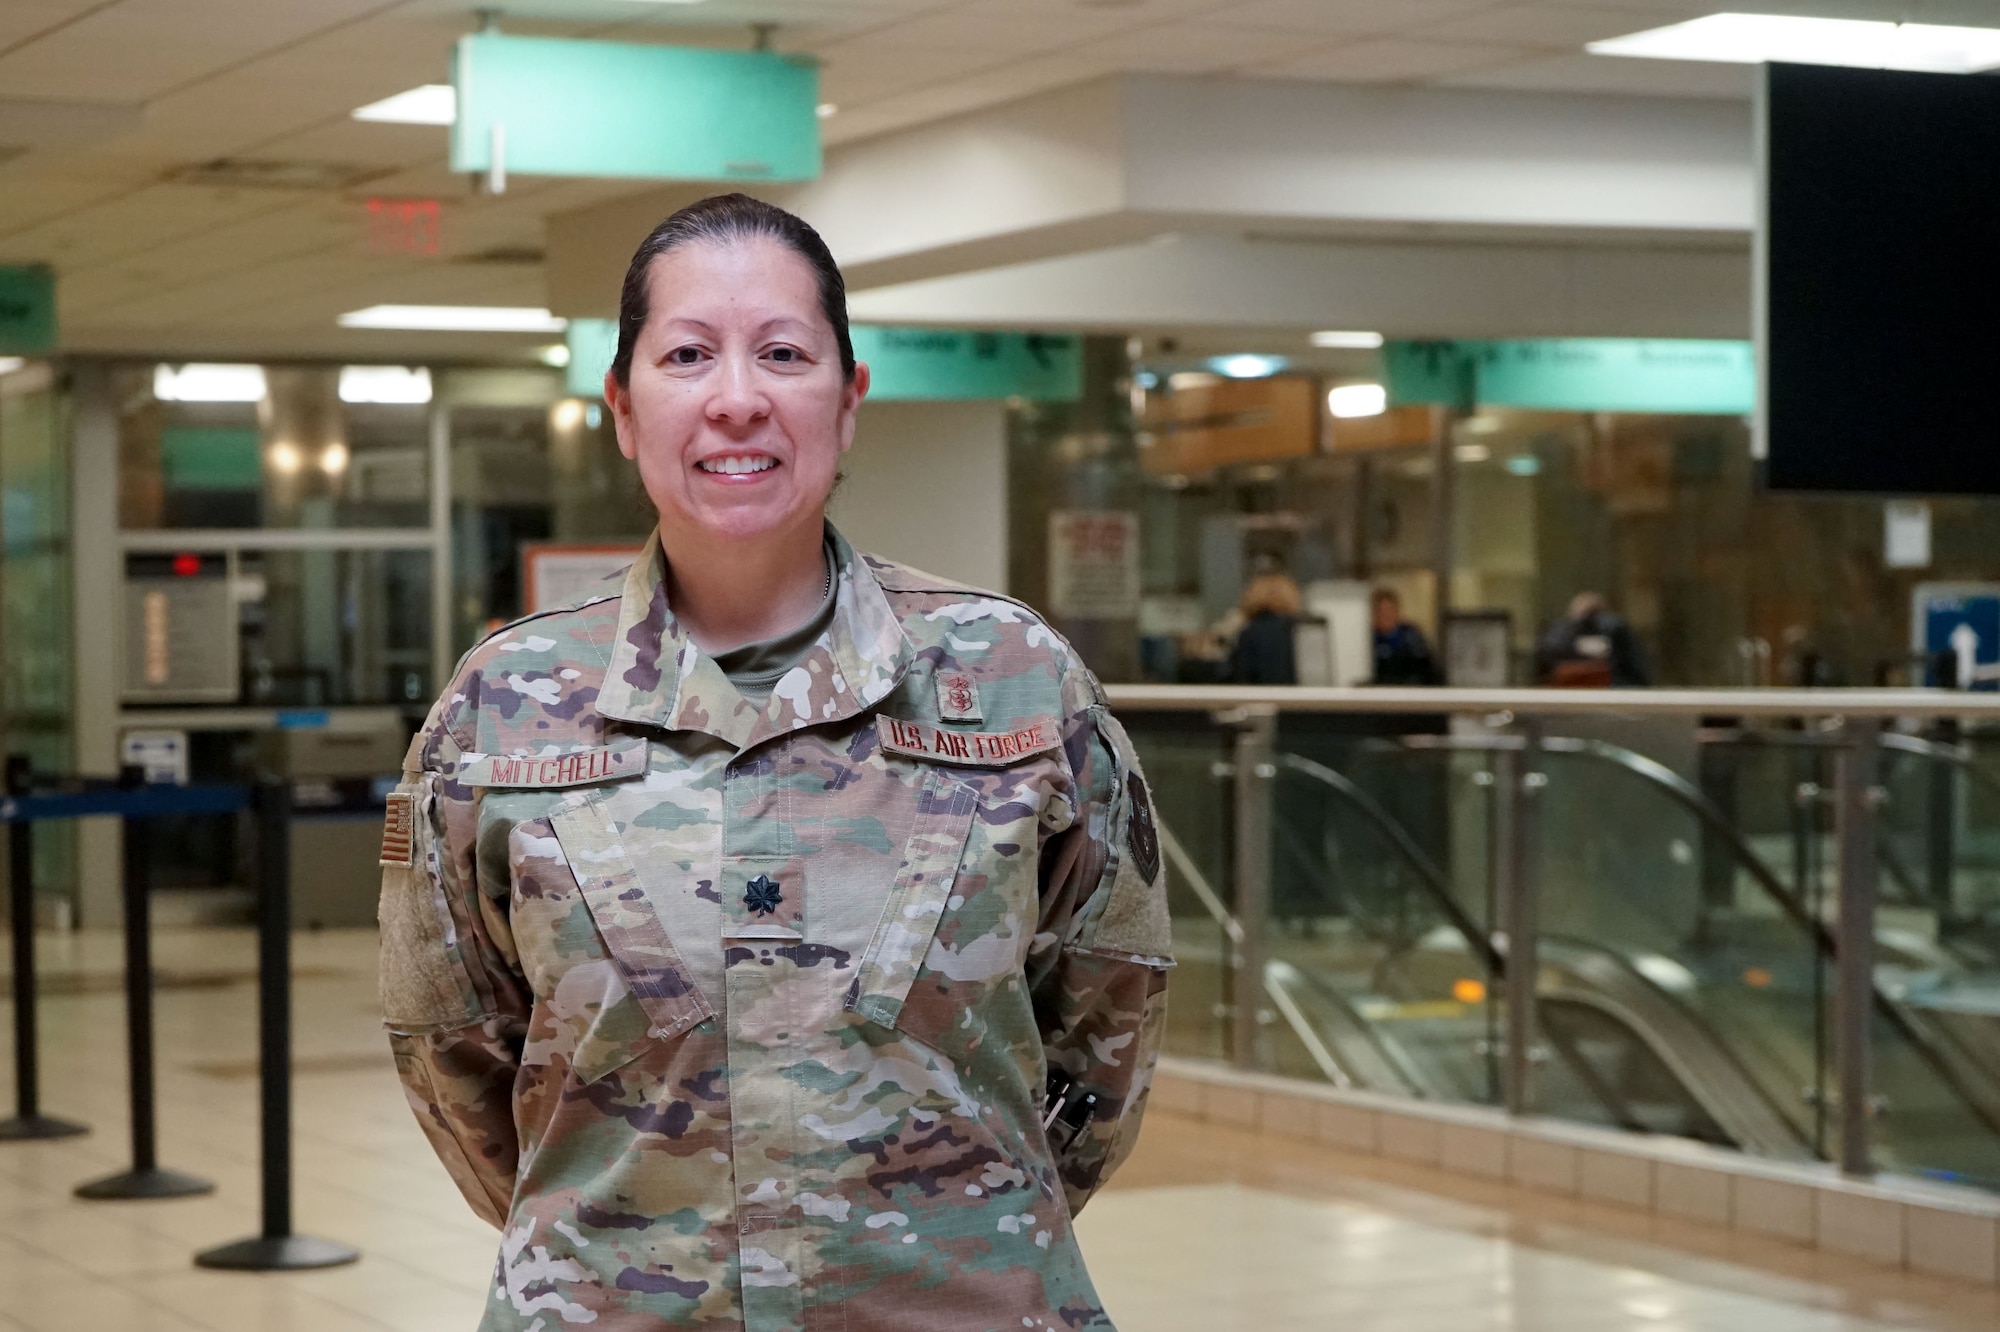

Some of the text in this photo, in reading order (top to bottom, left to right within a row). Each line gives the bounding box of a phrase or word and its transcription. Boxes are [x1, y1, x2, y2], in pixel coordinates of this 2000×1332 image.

[890, 721, 1046, 759] U.S. AIR FORCE
[490, 750, 614, 784] MITCHELL
